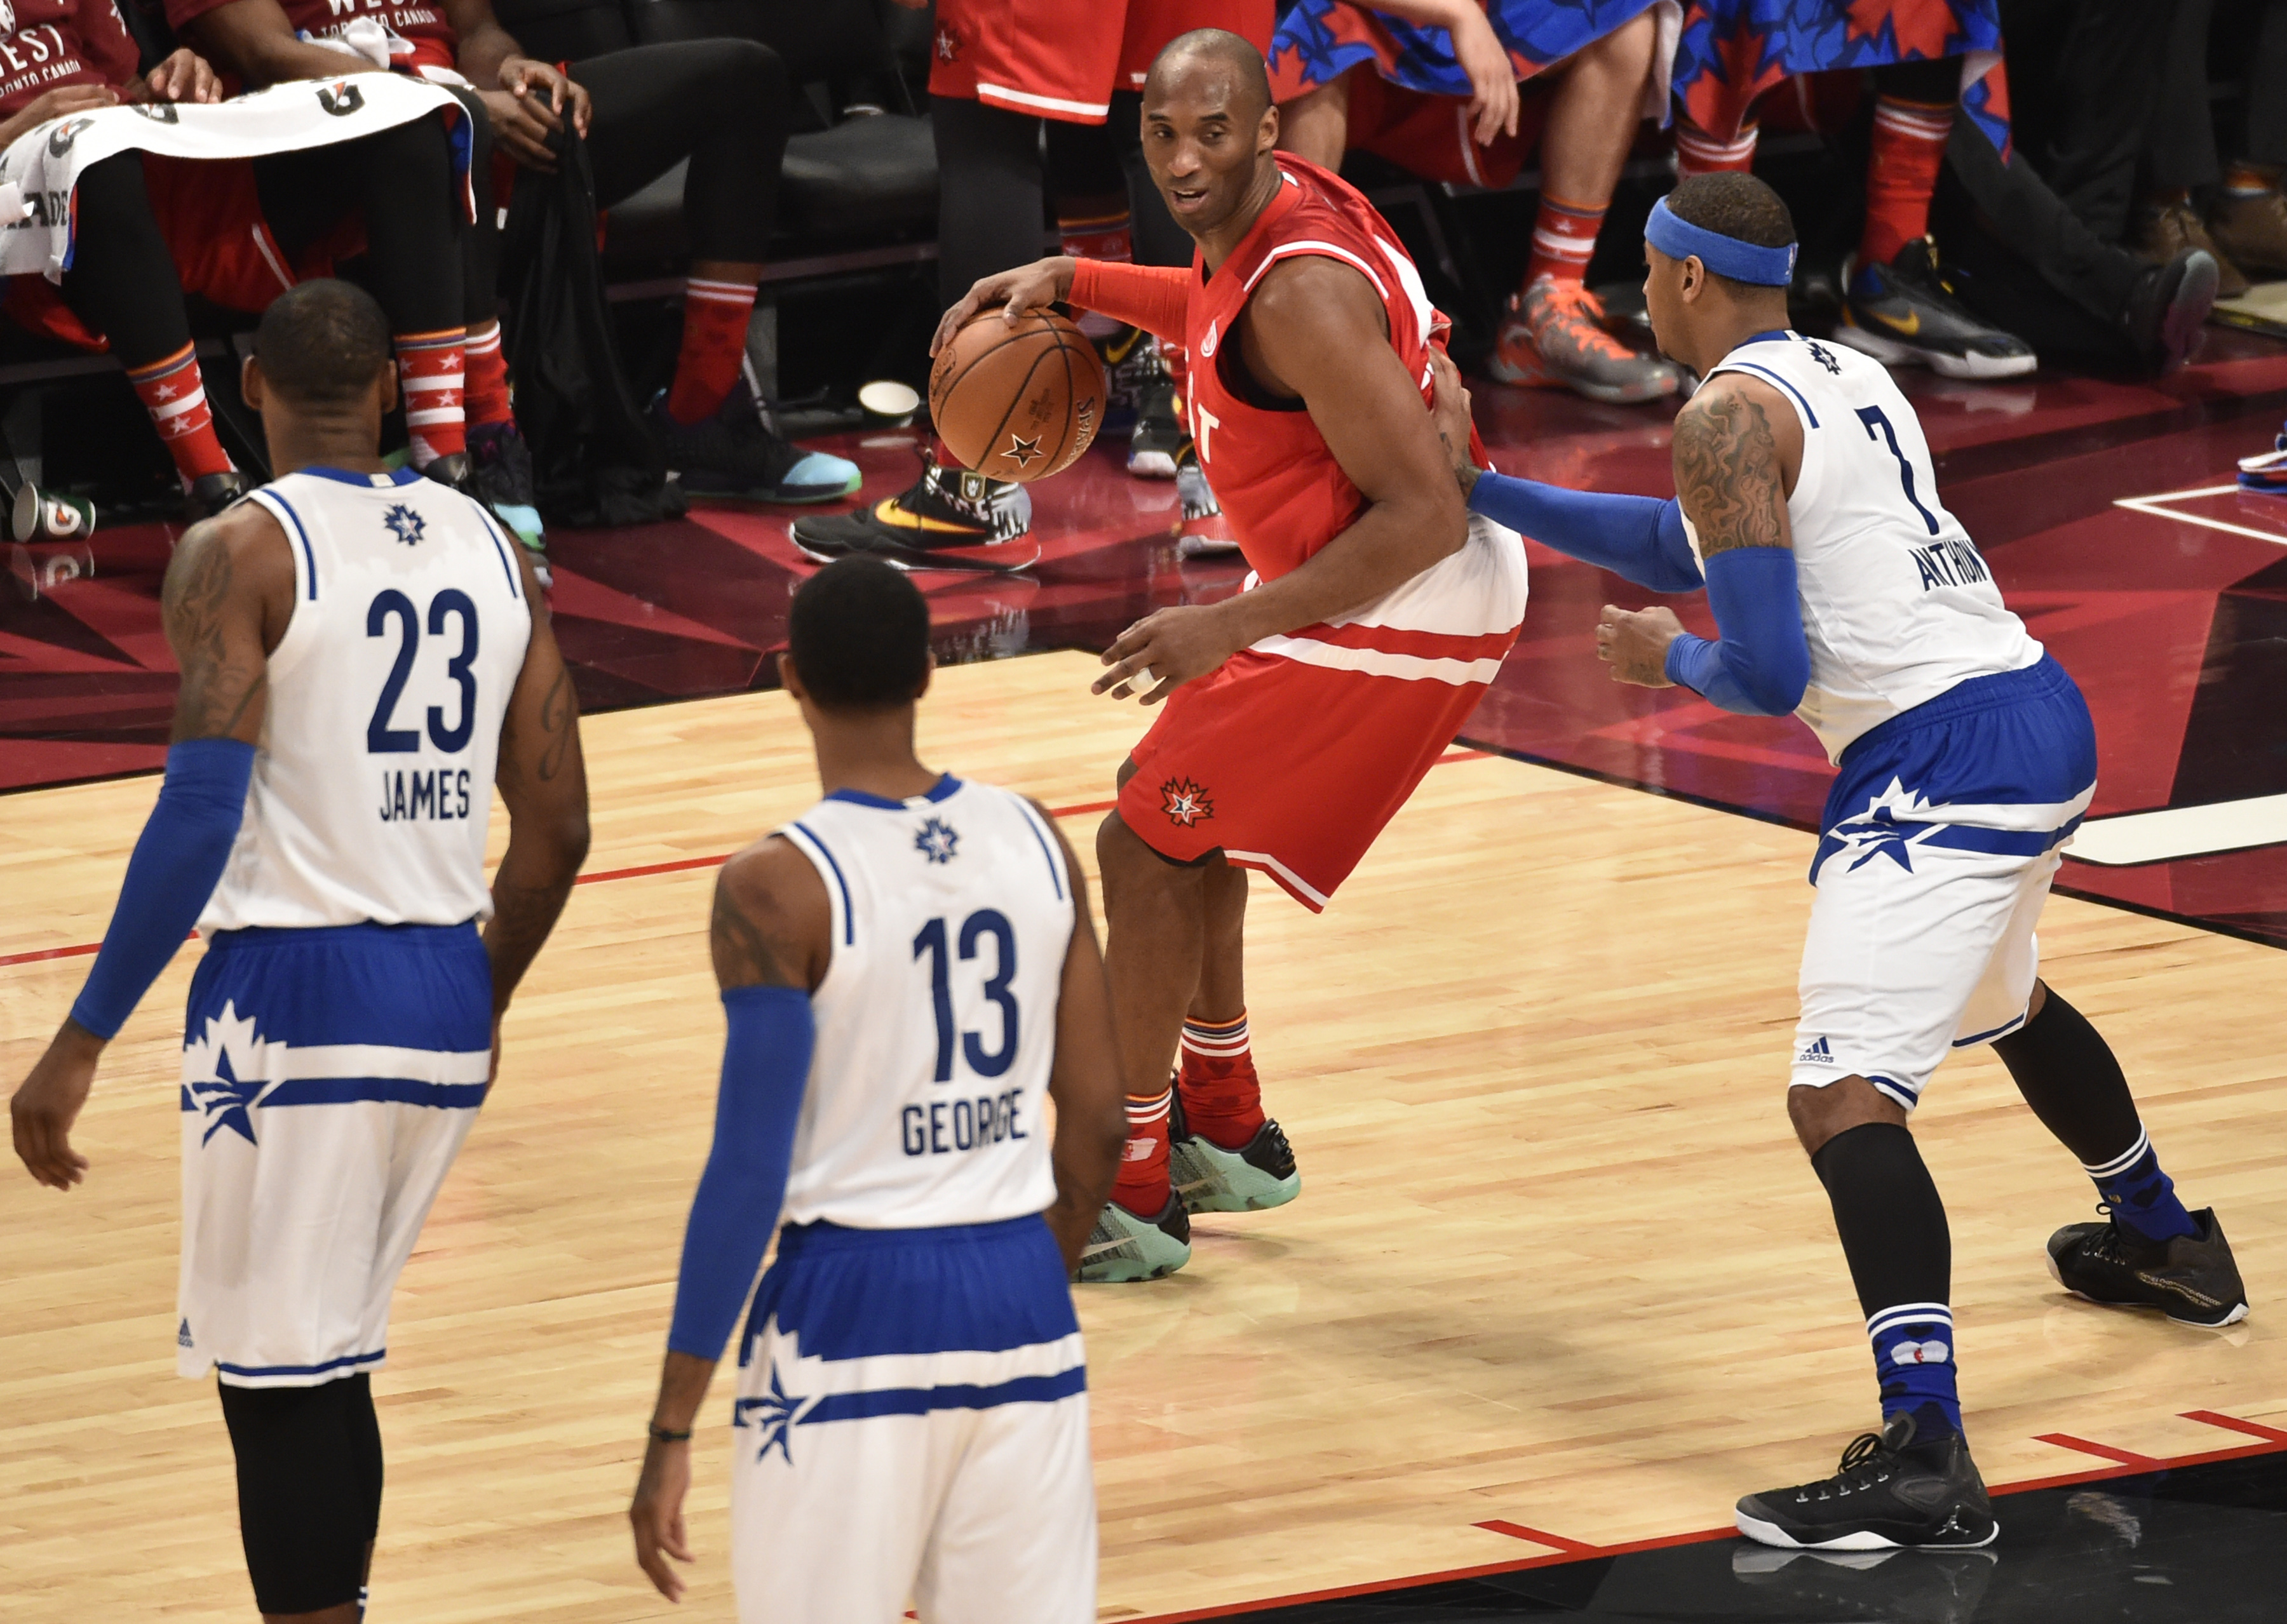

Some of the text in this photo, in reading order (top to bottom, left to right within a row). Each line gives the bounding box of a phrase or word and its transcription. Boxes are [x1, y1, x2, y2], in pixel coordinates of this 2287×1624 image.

[1854, 405, 1940, 536] 7
[367, 588, 480, 753] 23
[381, 768, 471, 822] JAMES
[913, 908, 1018, 1082] 13
[1799, 1054, 1834, 1063] adidas
[902, 1088, 1029, 1157] GEORGE
